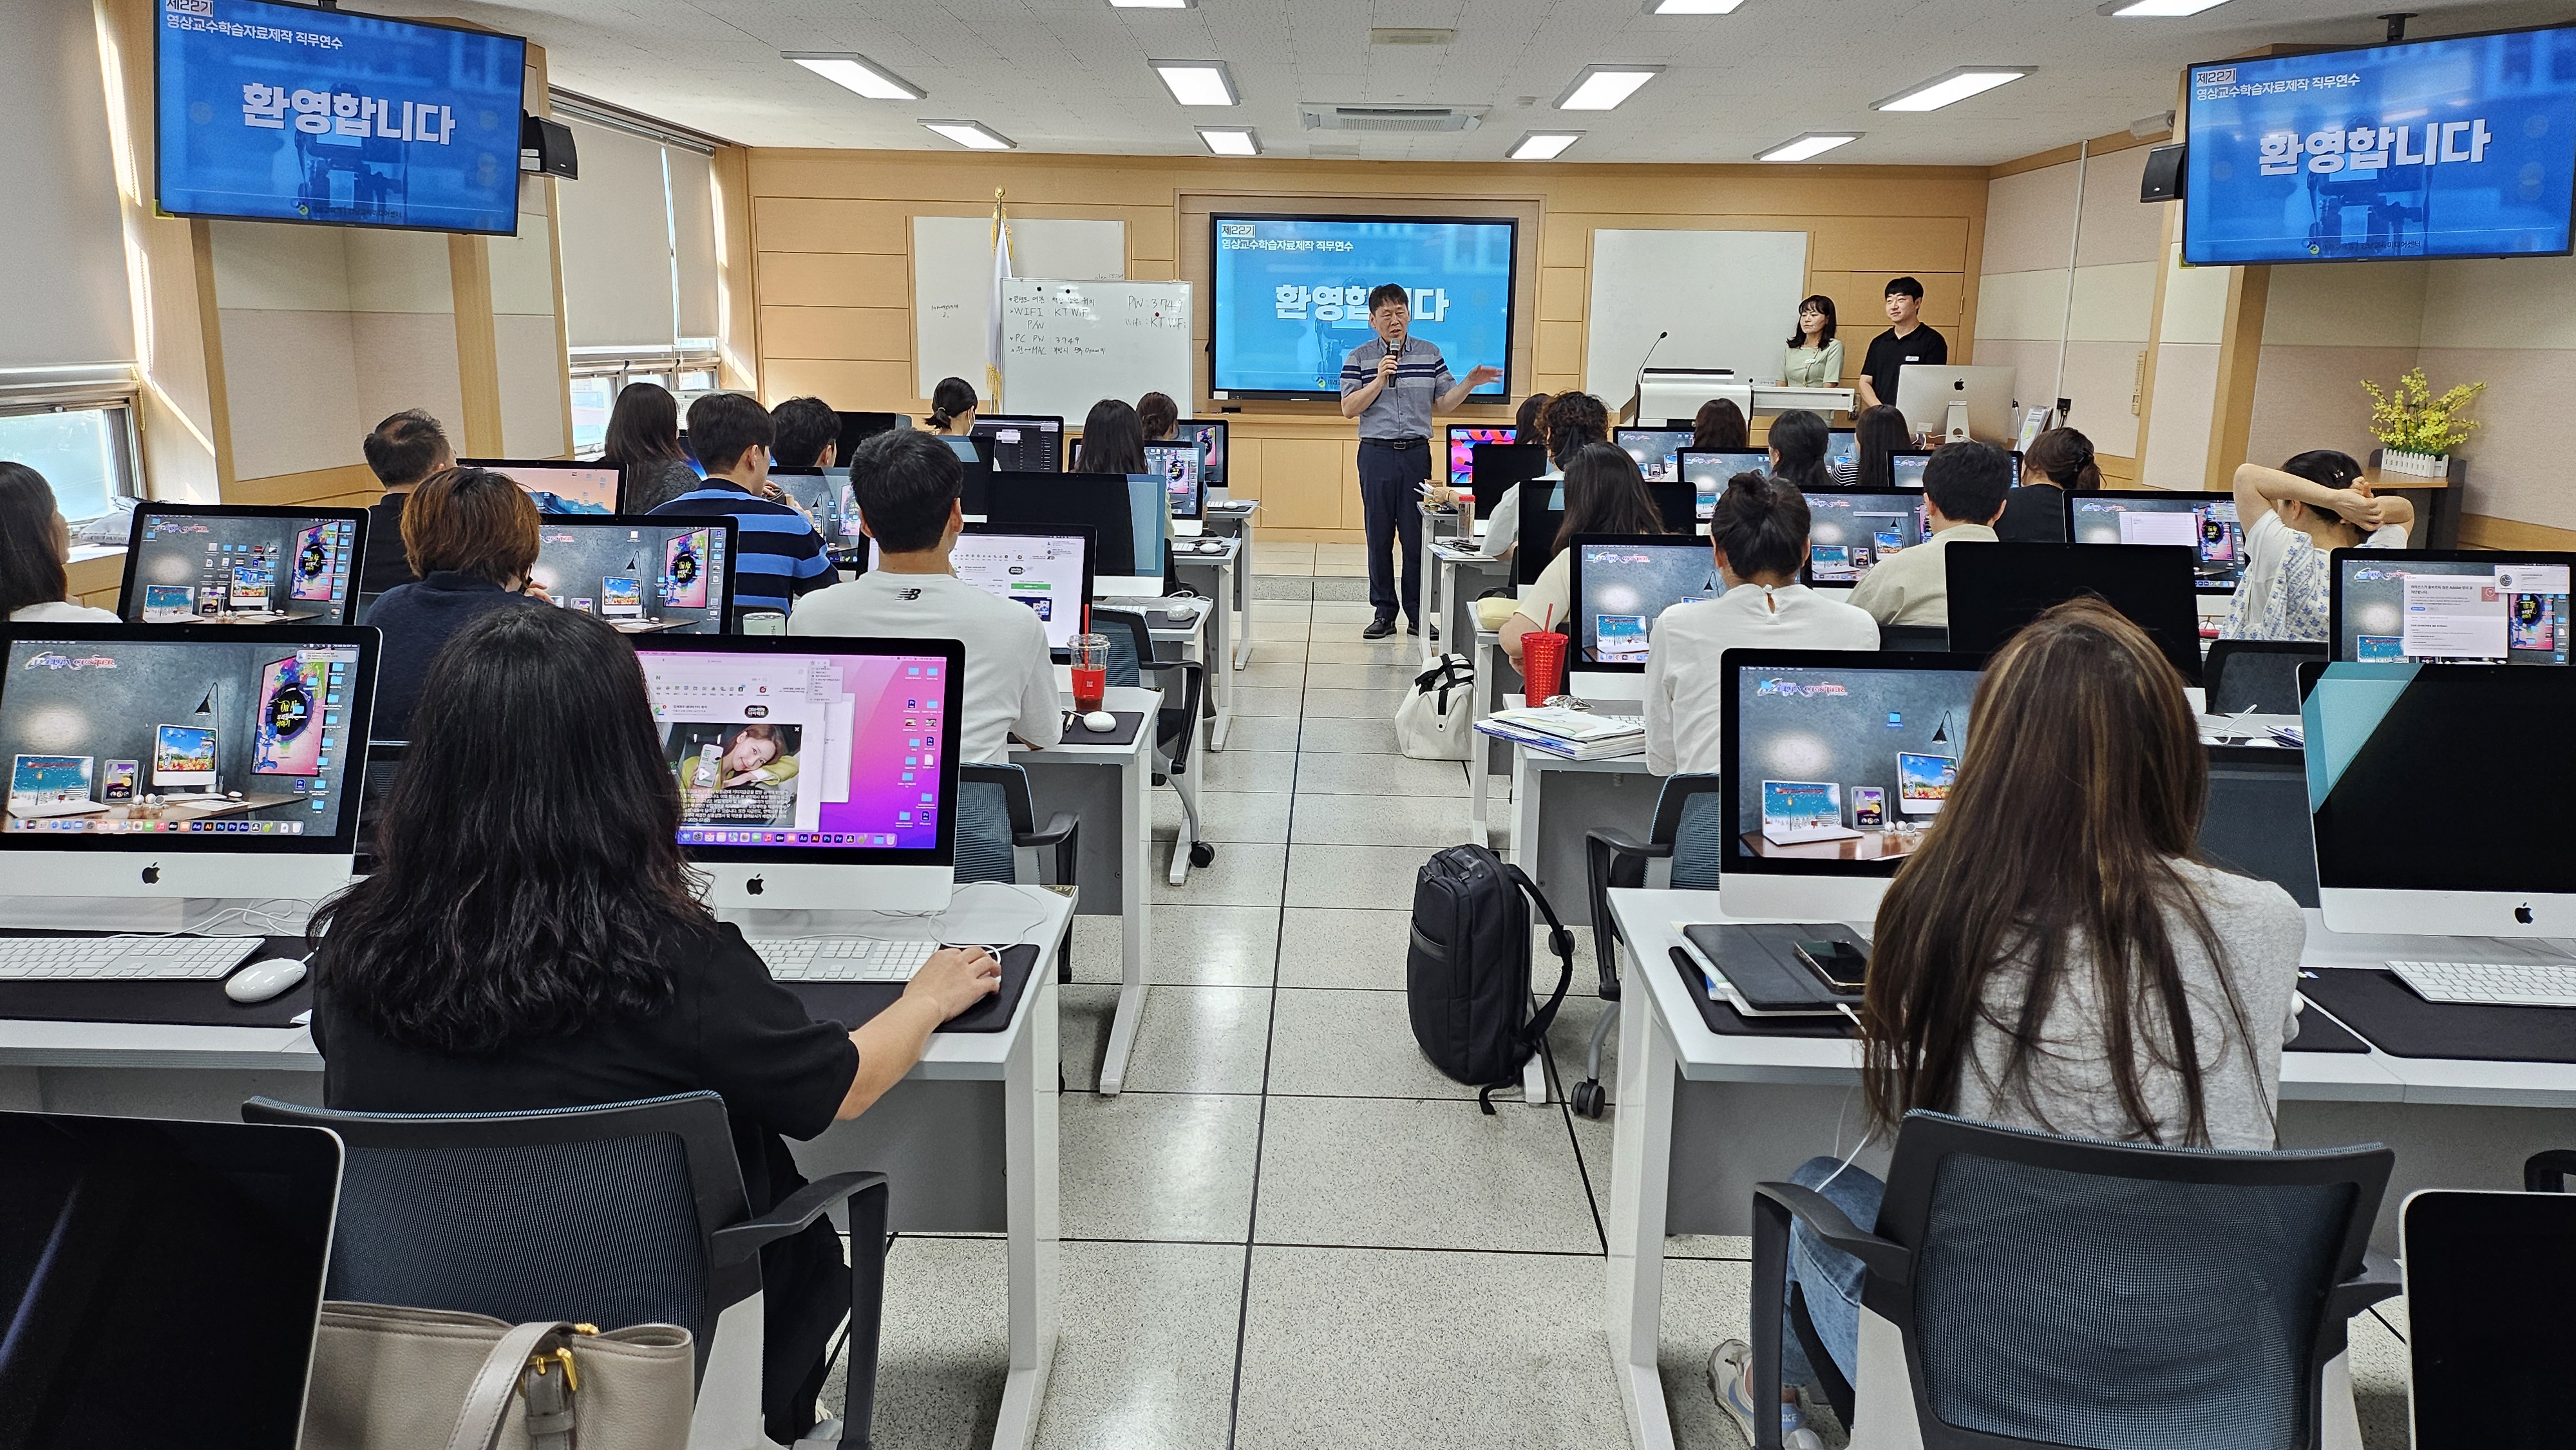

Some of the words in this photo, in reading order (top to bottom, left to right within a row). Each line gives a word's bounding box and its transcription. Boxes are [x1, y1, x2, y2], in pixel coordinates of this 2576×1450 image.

[167, 14, 292, 44] 영상교수학습자료제작
[296, 31, 343, 50] 직무연수
[2197, 70, 2236, 85] 제22기
[2197, 80, 2310, 100] 영상교수학습자료제작
[2312, 73, 2361, 89] 직무연수
[243, 82, 456, 146] 환영합니다
[2259, 118, 2492, 176] 환영합니다
[1222, 225, 1255, 236] 제22기
[1222, 239, 1314, 252] 영상교수학습자료제작
[1316, 240, 1354, 252] 직무연수
[1128, 295, 1144, 310] PW
[1151, 298, 1183, 313] 3749
[1275, 284, 1450, 323] 환영합다
[1014, 307, 1043, 317] WIFI
[1054, 308, 1068, 317] KT
[1027, 319, 1044, 330] P/W
[1150, 317, 1165, 328] KT
[1015, 334, 1025, 343] PC
[1782, 1413, 1797, 1422] IKE
